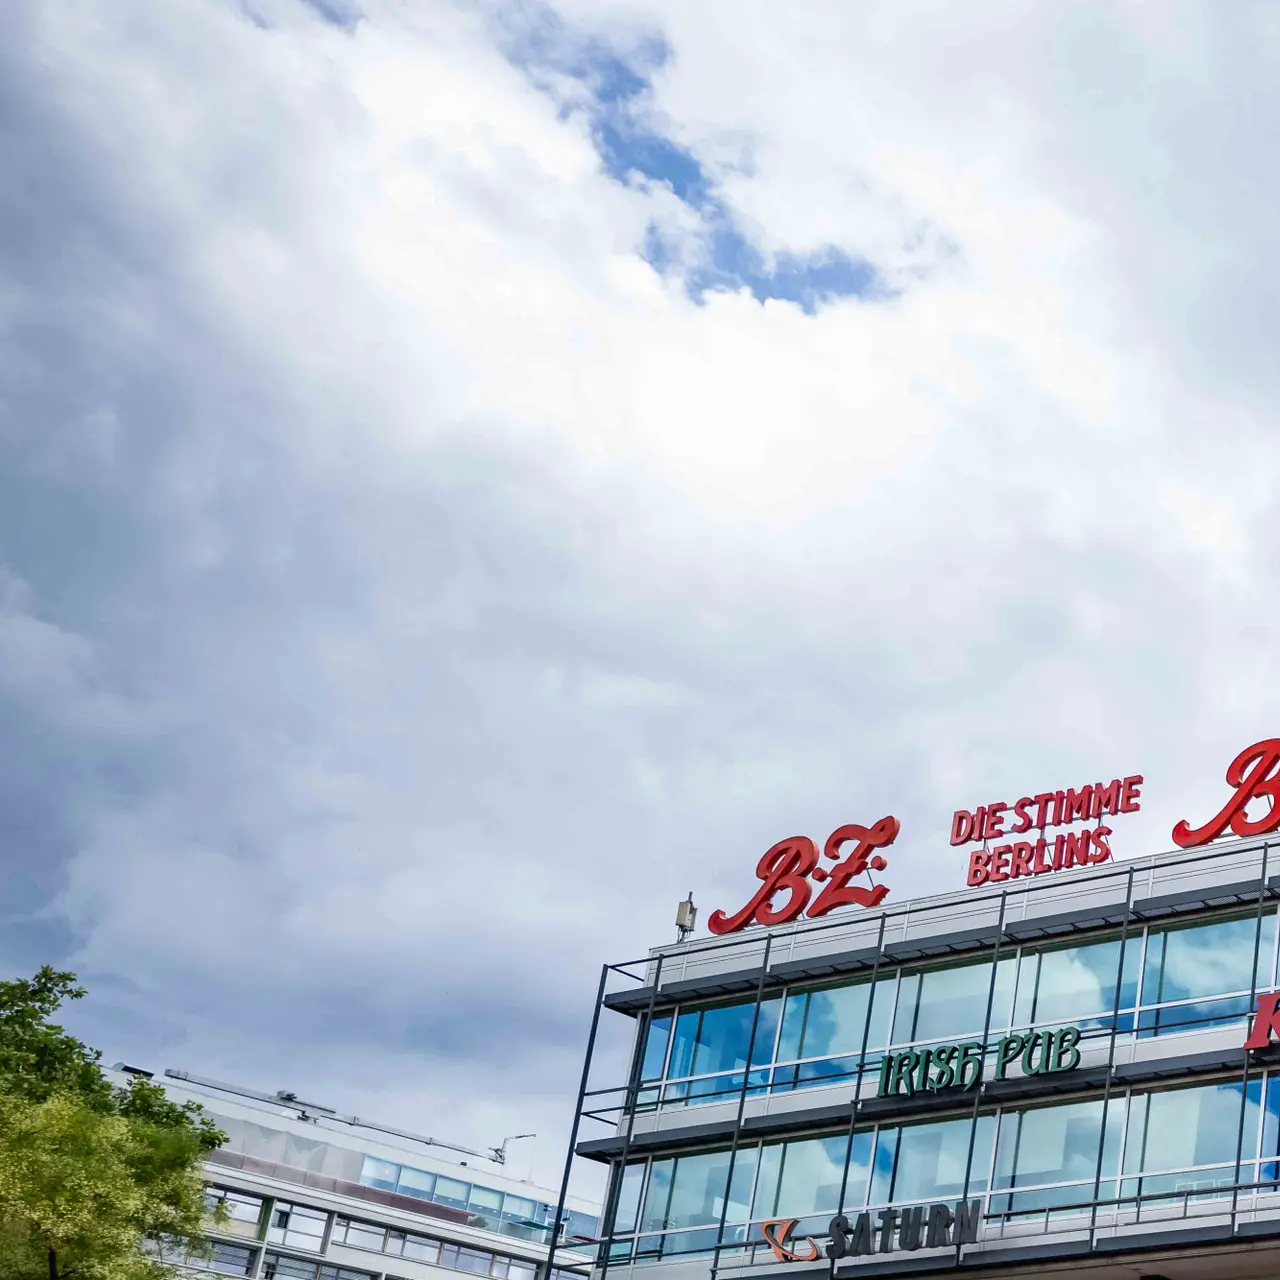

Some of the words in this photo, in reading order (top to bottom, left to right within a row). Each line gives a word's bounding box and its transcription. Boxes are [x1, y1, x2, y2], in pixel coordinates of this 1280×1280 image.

[949, 807, 1006, 846] DIE
[1011, 774, 1144, 835] STIMME
[967, 825, 1113, 887] BERLINS
[994, 1026, 1082, 1079] PUB
[826, 1198, 983, 1259] SATURN
